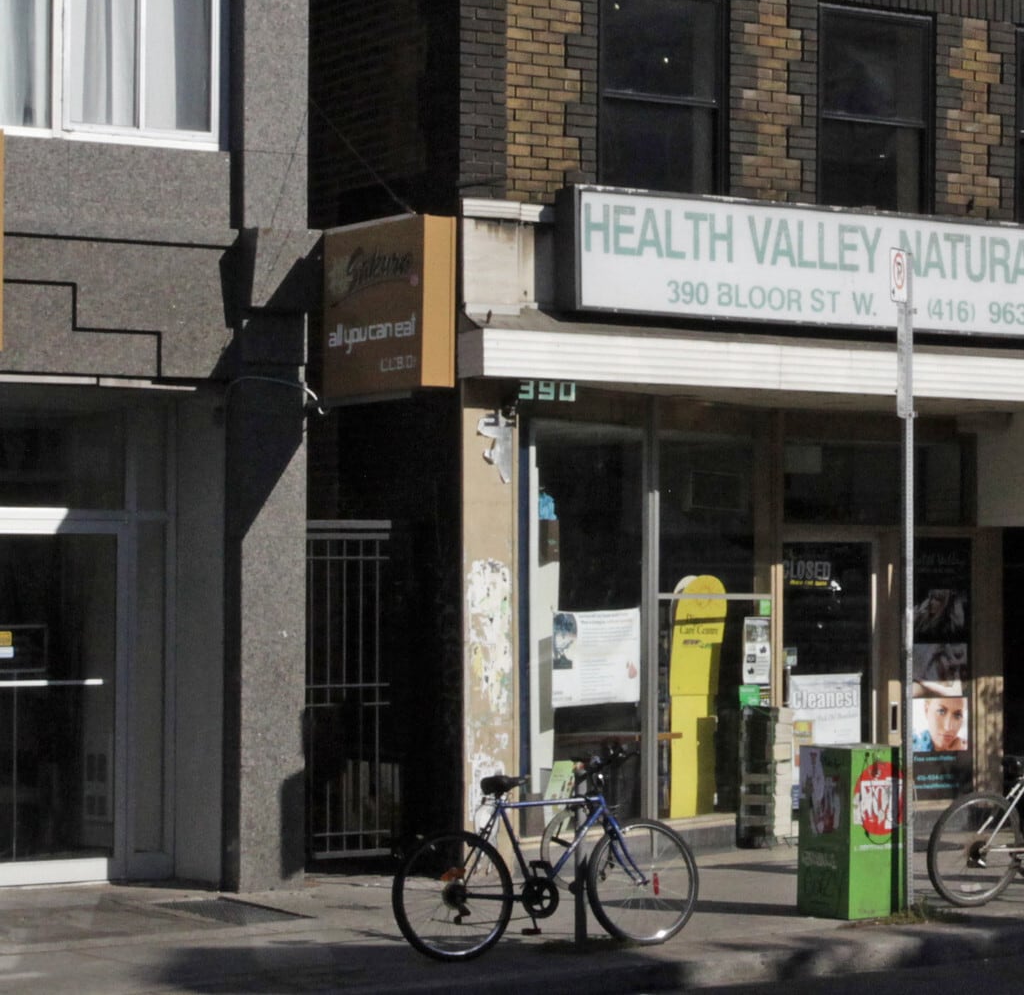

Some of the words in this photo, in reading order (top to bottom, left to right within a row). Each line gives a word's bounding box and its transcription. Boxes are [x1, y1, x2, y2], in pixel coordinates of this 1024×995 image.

[584, 202, 734, 264] HEALTH
[747, 214, 882, 274] VALLEY
[667, 279, 709, 306] 390
[717, 283, 802, 313] BLOOR
[810, 289, 840, 314] ST
[852, 291, 877, 317] W.
[927, 297, 976, 324] (416)
[344, 324, 368, 354] you
[368, 322, 393, 341] can
[394, 311, 416, 338] eat
[518, 380, 576, 402] 390
[793, 689, 858, 709] Cleanest
